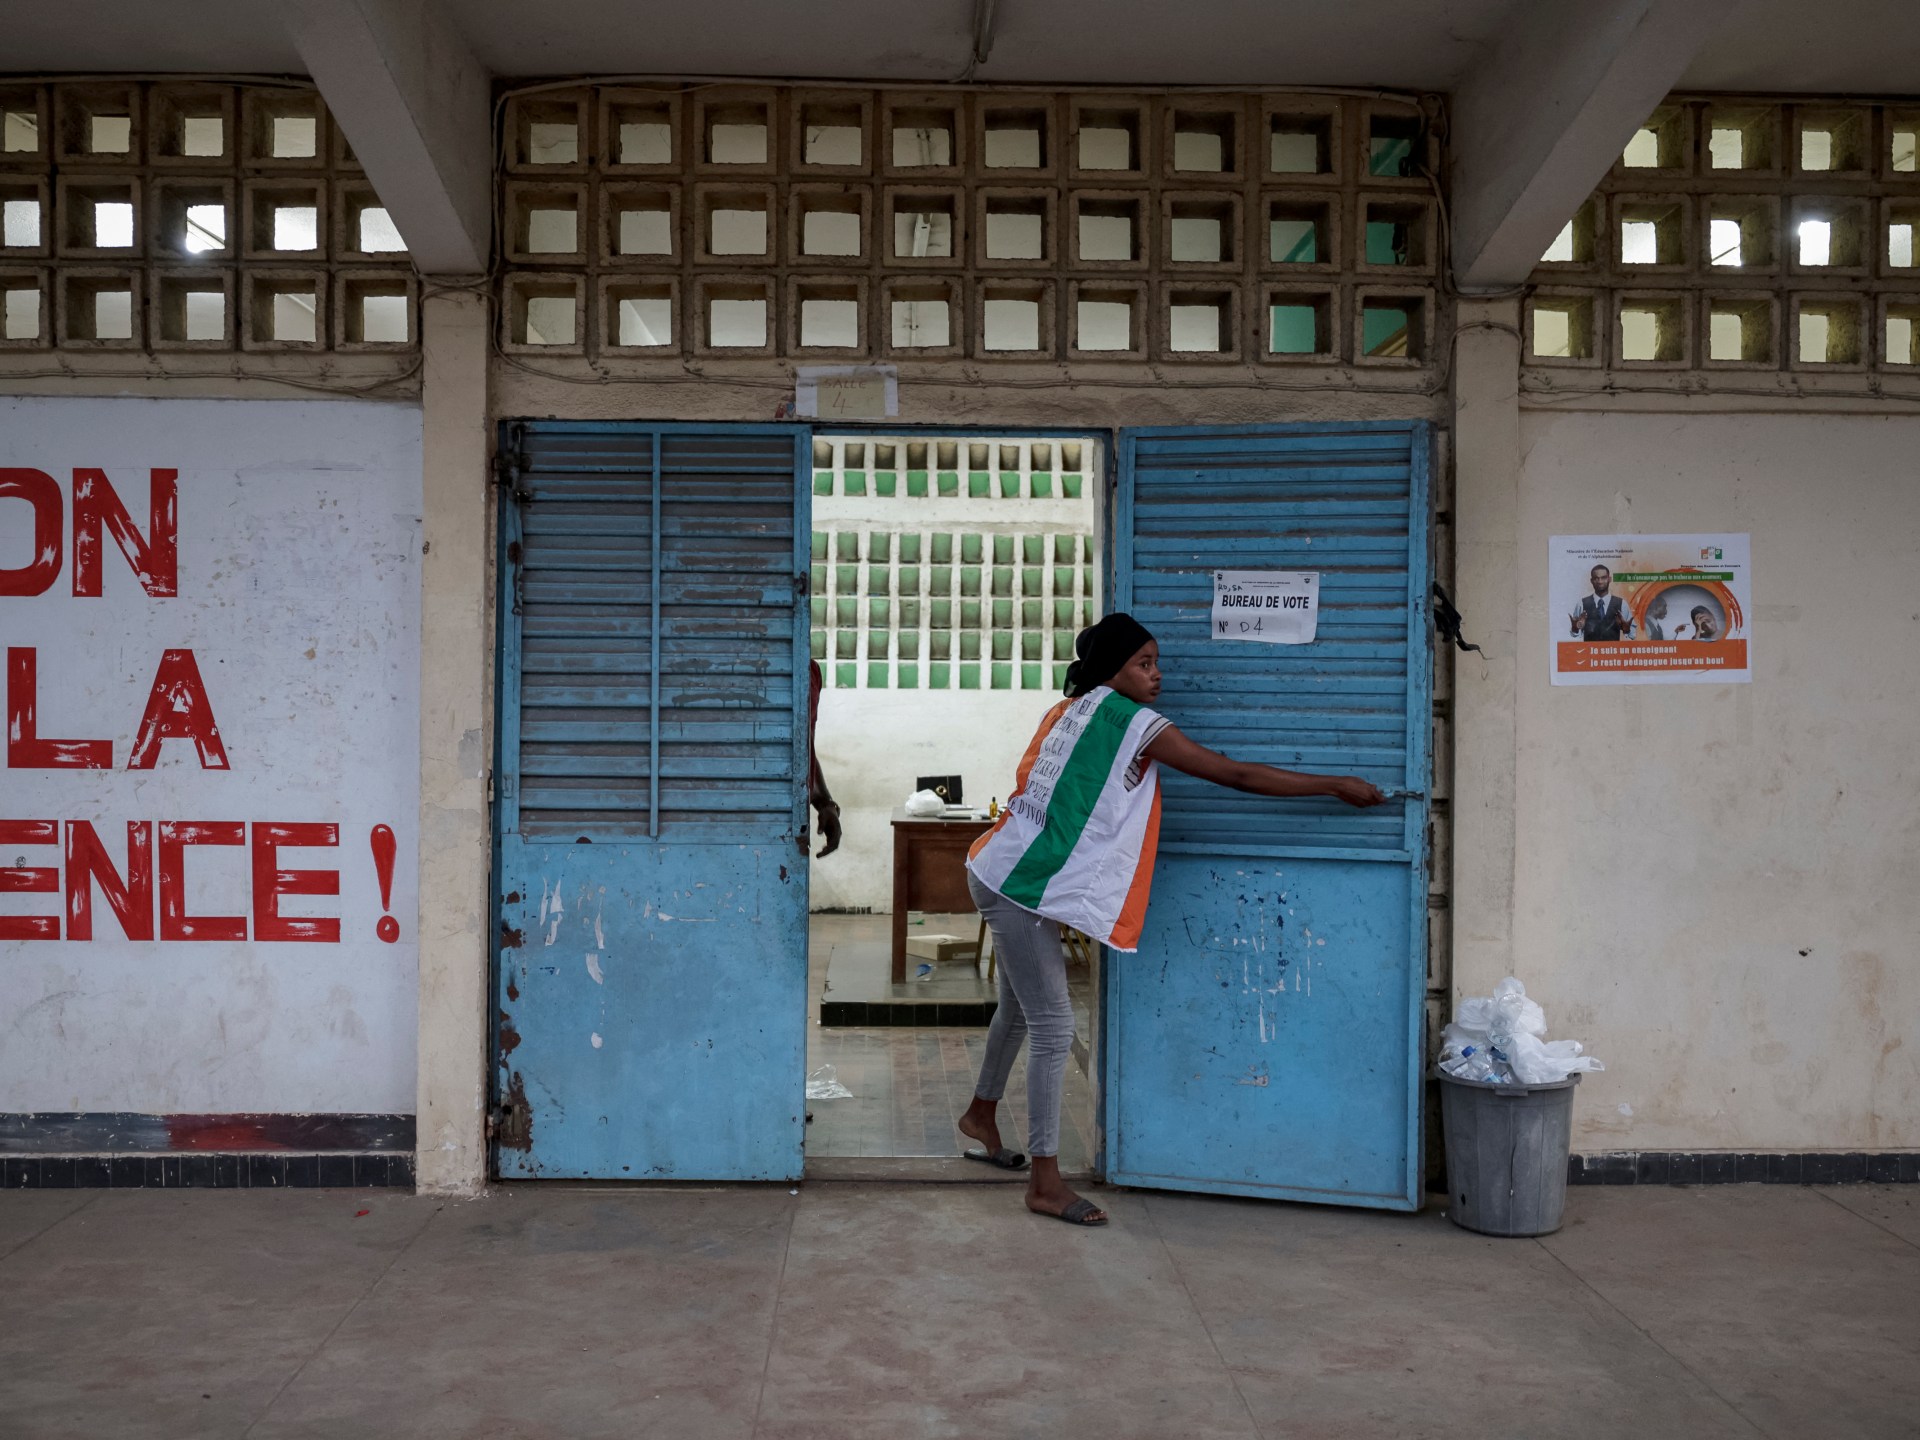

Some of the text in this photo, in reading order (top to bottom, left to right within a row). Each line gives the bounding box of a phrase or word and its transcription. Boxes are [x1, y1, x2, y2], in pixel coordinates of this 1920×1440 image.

[832, 391, 853, 414] 4
[0, 467, 178, 598] ON
[1222, 594, 1310, 609] BUREAU DE VOTE
[1600, 646, 1618, 654] suis
[1631, 645, 1678, 655] enseignant
[1600, 658, 1621, 666] reste
[1623, 658, 1668, 667] pédagogue
[1706, 657, 1725, 665] bout
[7, 647, 231, 770] LA
